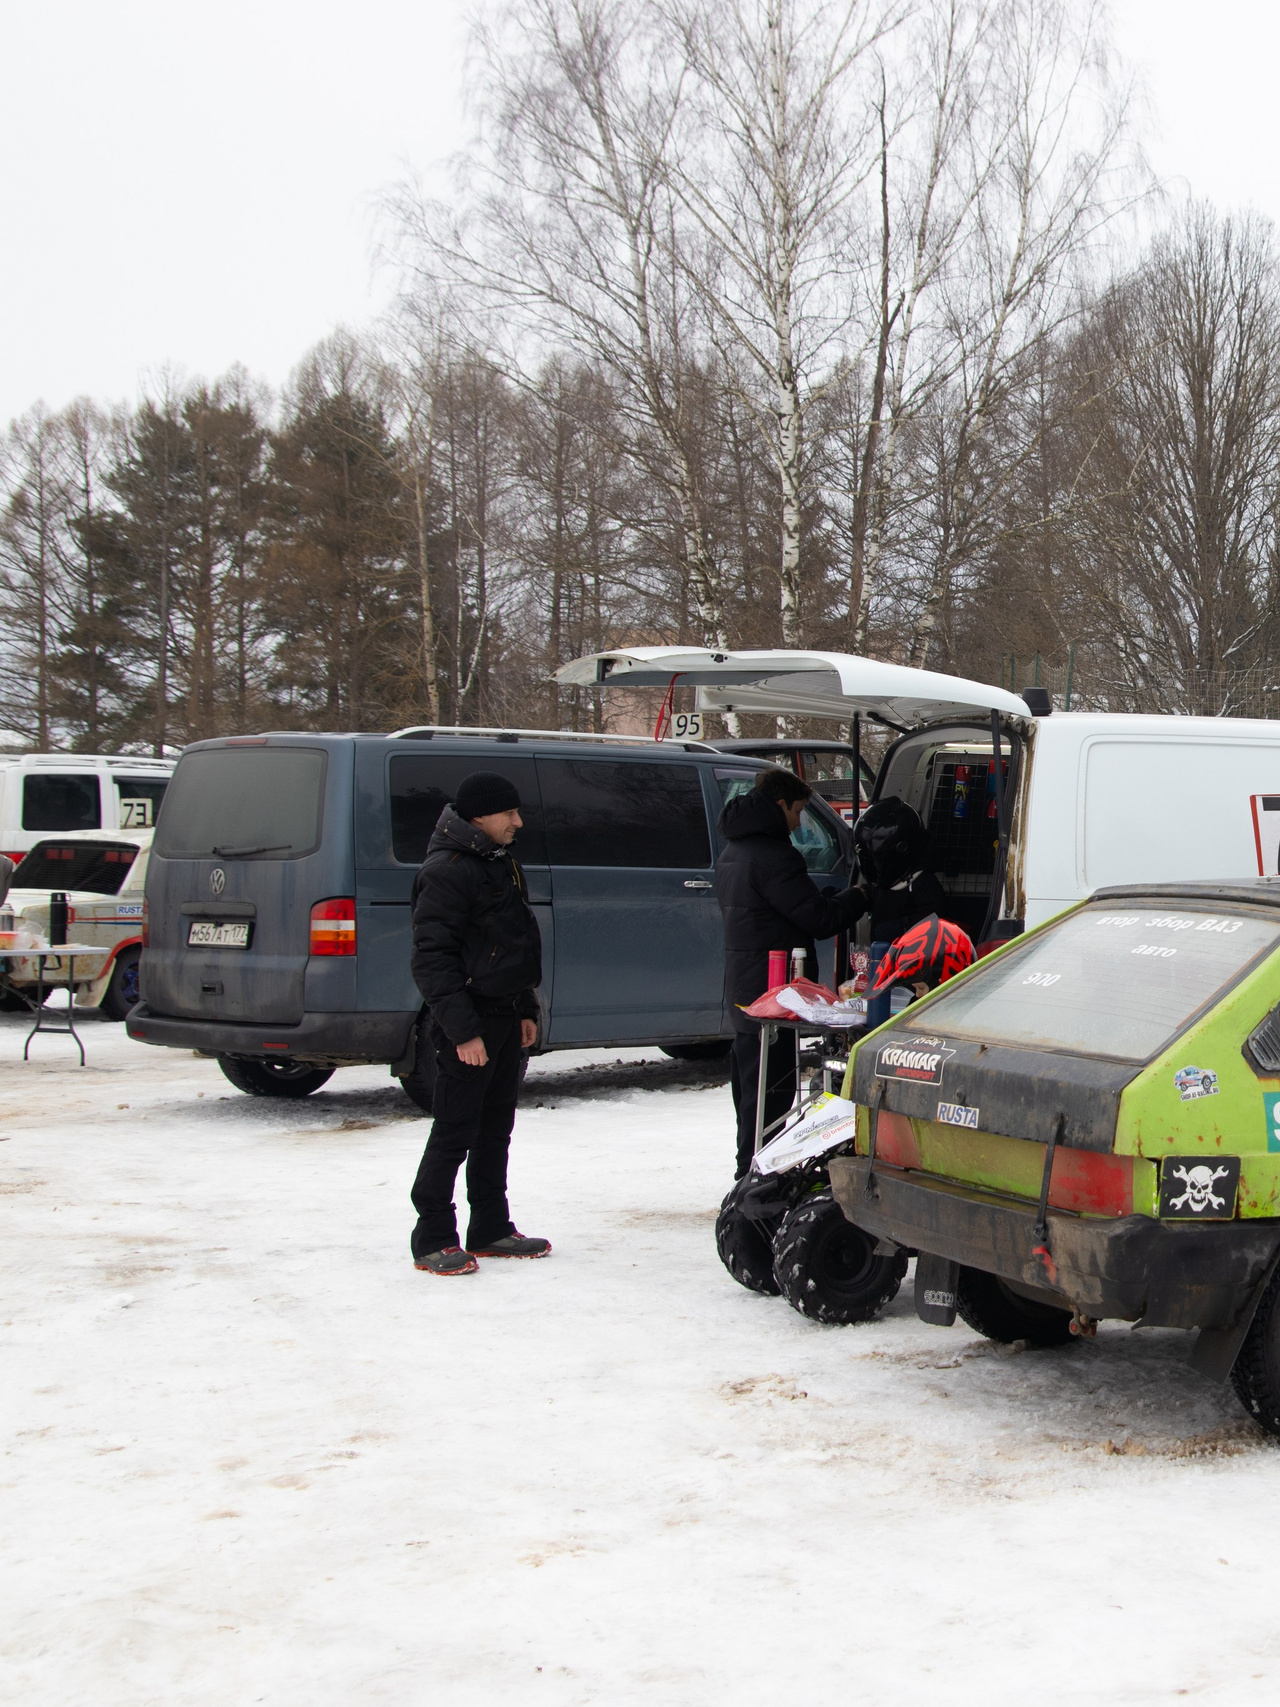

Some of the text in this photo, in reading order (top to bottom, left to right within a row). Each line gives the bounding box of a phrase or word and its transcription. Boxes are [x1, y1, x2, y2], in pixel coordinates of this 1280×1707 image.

[675, 714, 700, 737] 95
[123, 803, 146, 827] 73
[232, 926, 247, 938] 177
[1194, 918, 1243, 933] ВАЗ
[1131, 944, 1177, 957] авто
[881, 1047, 942, 1072] KRAMAR
[938, 1103, 978, 1127] RUSTA
[830, 1120, 854, 1135] brembo
